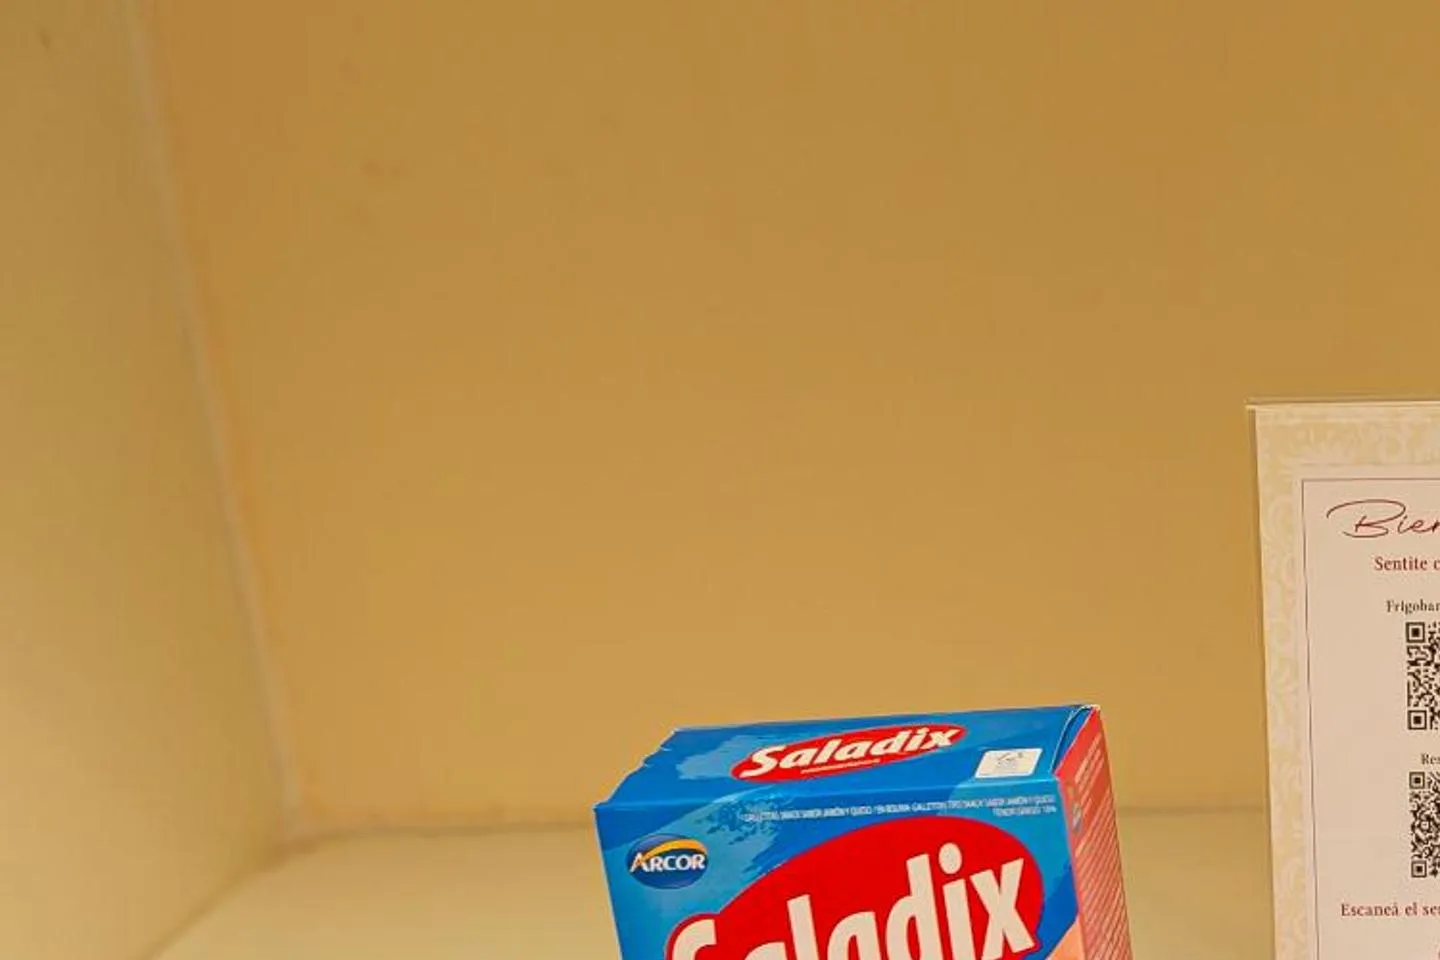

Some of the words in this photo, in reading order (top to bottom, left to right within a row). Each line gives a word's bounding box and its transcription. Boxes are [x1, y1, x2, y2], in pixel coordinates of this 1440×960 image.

[1374, 556, 1428, 571] Sentite
[1386, 600, 1440, 614] Frigobar
[739, 727, 960, 778] Saladix
[630, 852, 706, 873] ARCOR
[1341, 903, 1399, 917] Escaneá
[1405, 902, 1418, 916] el
